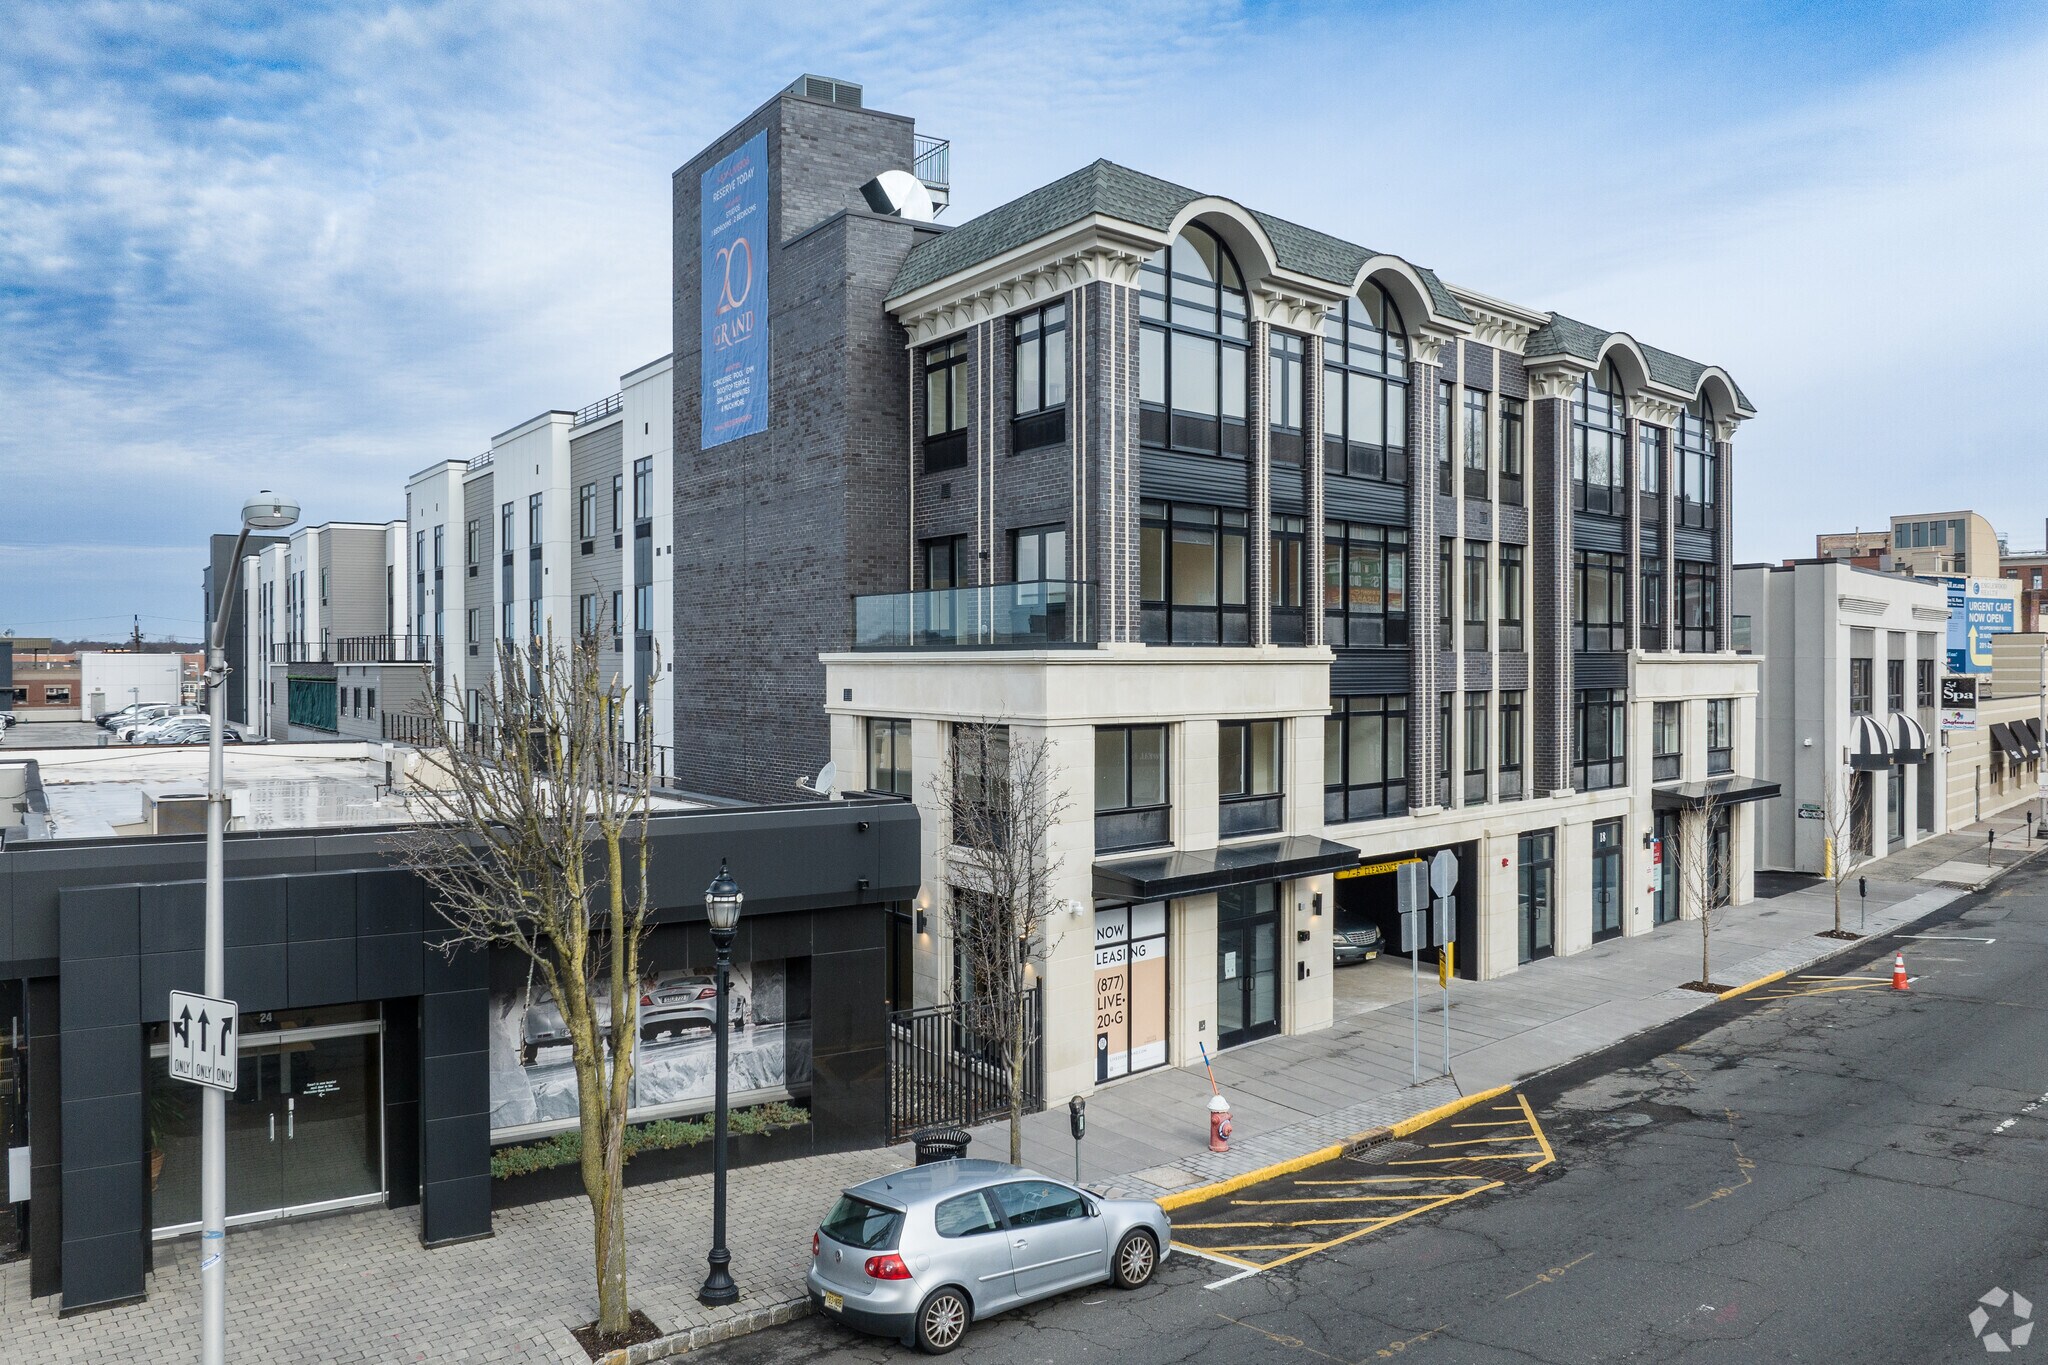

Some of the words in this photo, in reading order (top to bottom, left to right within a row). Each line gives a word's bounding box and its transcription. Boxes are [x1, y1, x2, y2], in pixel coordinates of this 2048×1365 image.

[713, 179, 736, 203] RESERVE
[736, 166, 755, 187] TODAY
[725, 203, 740, 219] STUDIOS
[736, 203, 757, 222] BEDROOMS
[715, 237, 752, 317] 20
[713, 310, 755, 347] GRAND
[1968, 601, 1994, 612] URGENT
[1995, 602, 2012, 612] CARE
[1968, 613, 1986, 622] NOW
[1986, 613, 2004, 623] OPEN
[1943, 688, 1974, 702] Spa
[1096, 924, 1124, 941] NOW
[1096, 944, 1146, 966] LEASING
[1097, 973, 1124, 995] (877)
[259, 1012, 273, 1023] 24
[174, 1058, 191, 1074] ONLY
[196, 1063, 213, 1080] ONLY
[216, 1067, 233, 1084] ONLY
